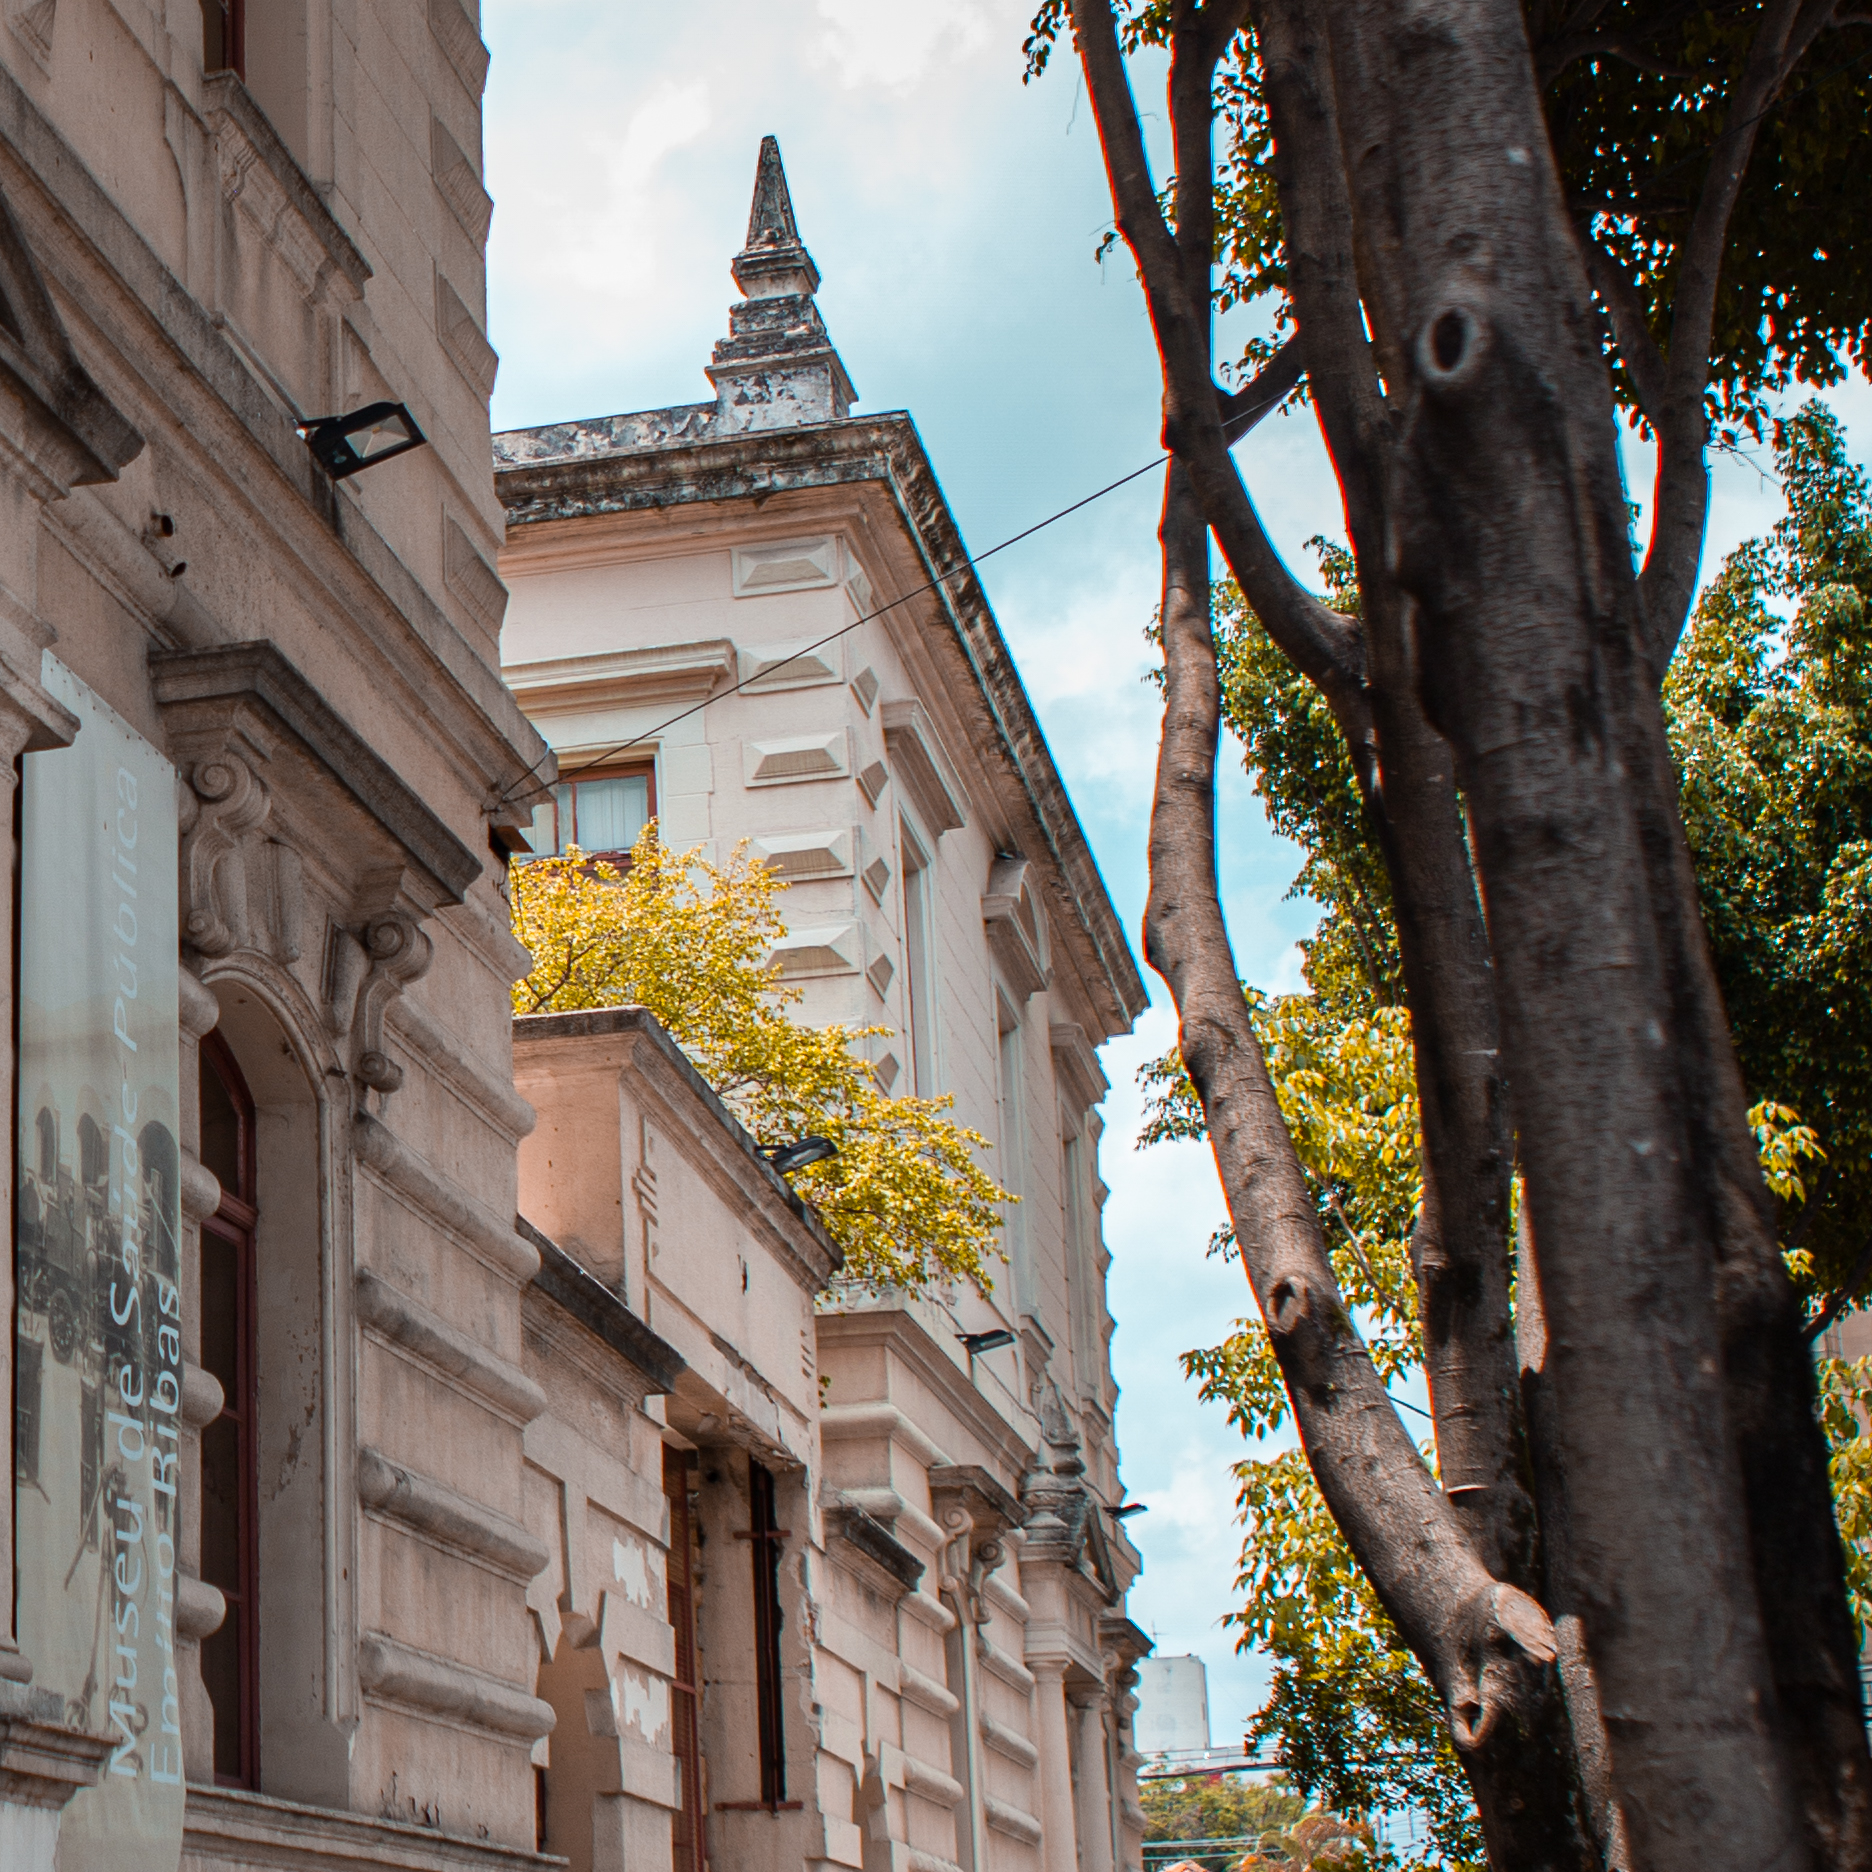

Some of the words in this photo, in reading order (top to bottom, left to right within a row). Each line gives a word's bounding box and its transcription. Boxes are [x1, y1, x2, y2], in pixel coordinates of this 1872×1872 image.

[112, 766, 140, 1054] Pública
[109, 1081, 143, 1331] Saúde
[107, 1362, 144, 1462] de
[149, 1284, 182, 1497] Ribas
[108, 1496, 144, 1779] Museu
[149, 1531, 181, 1786] Emílio
